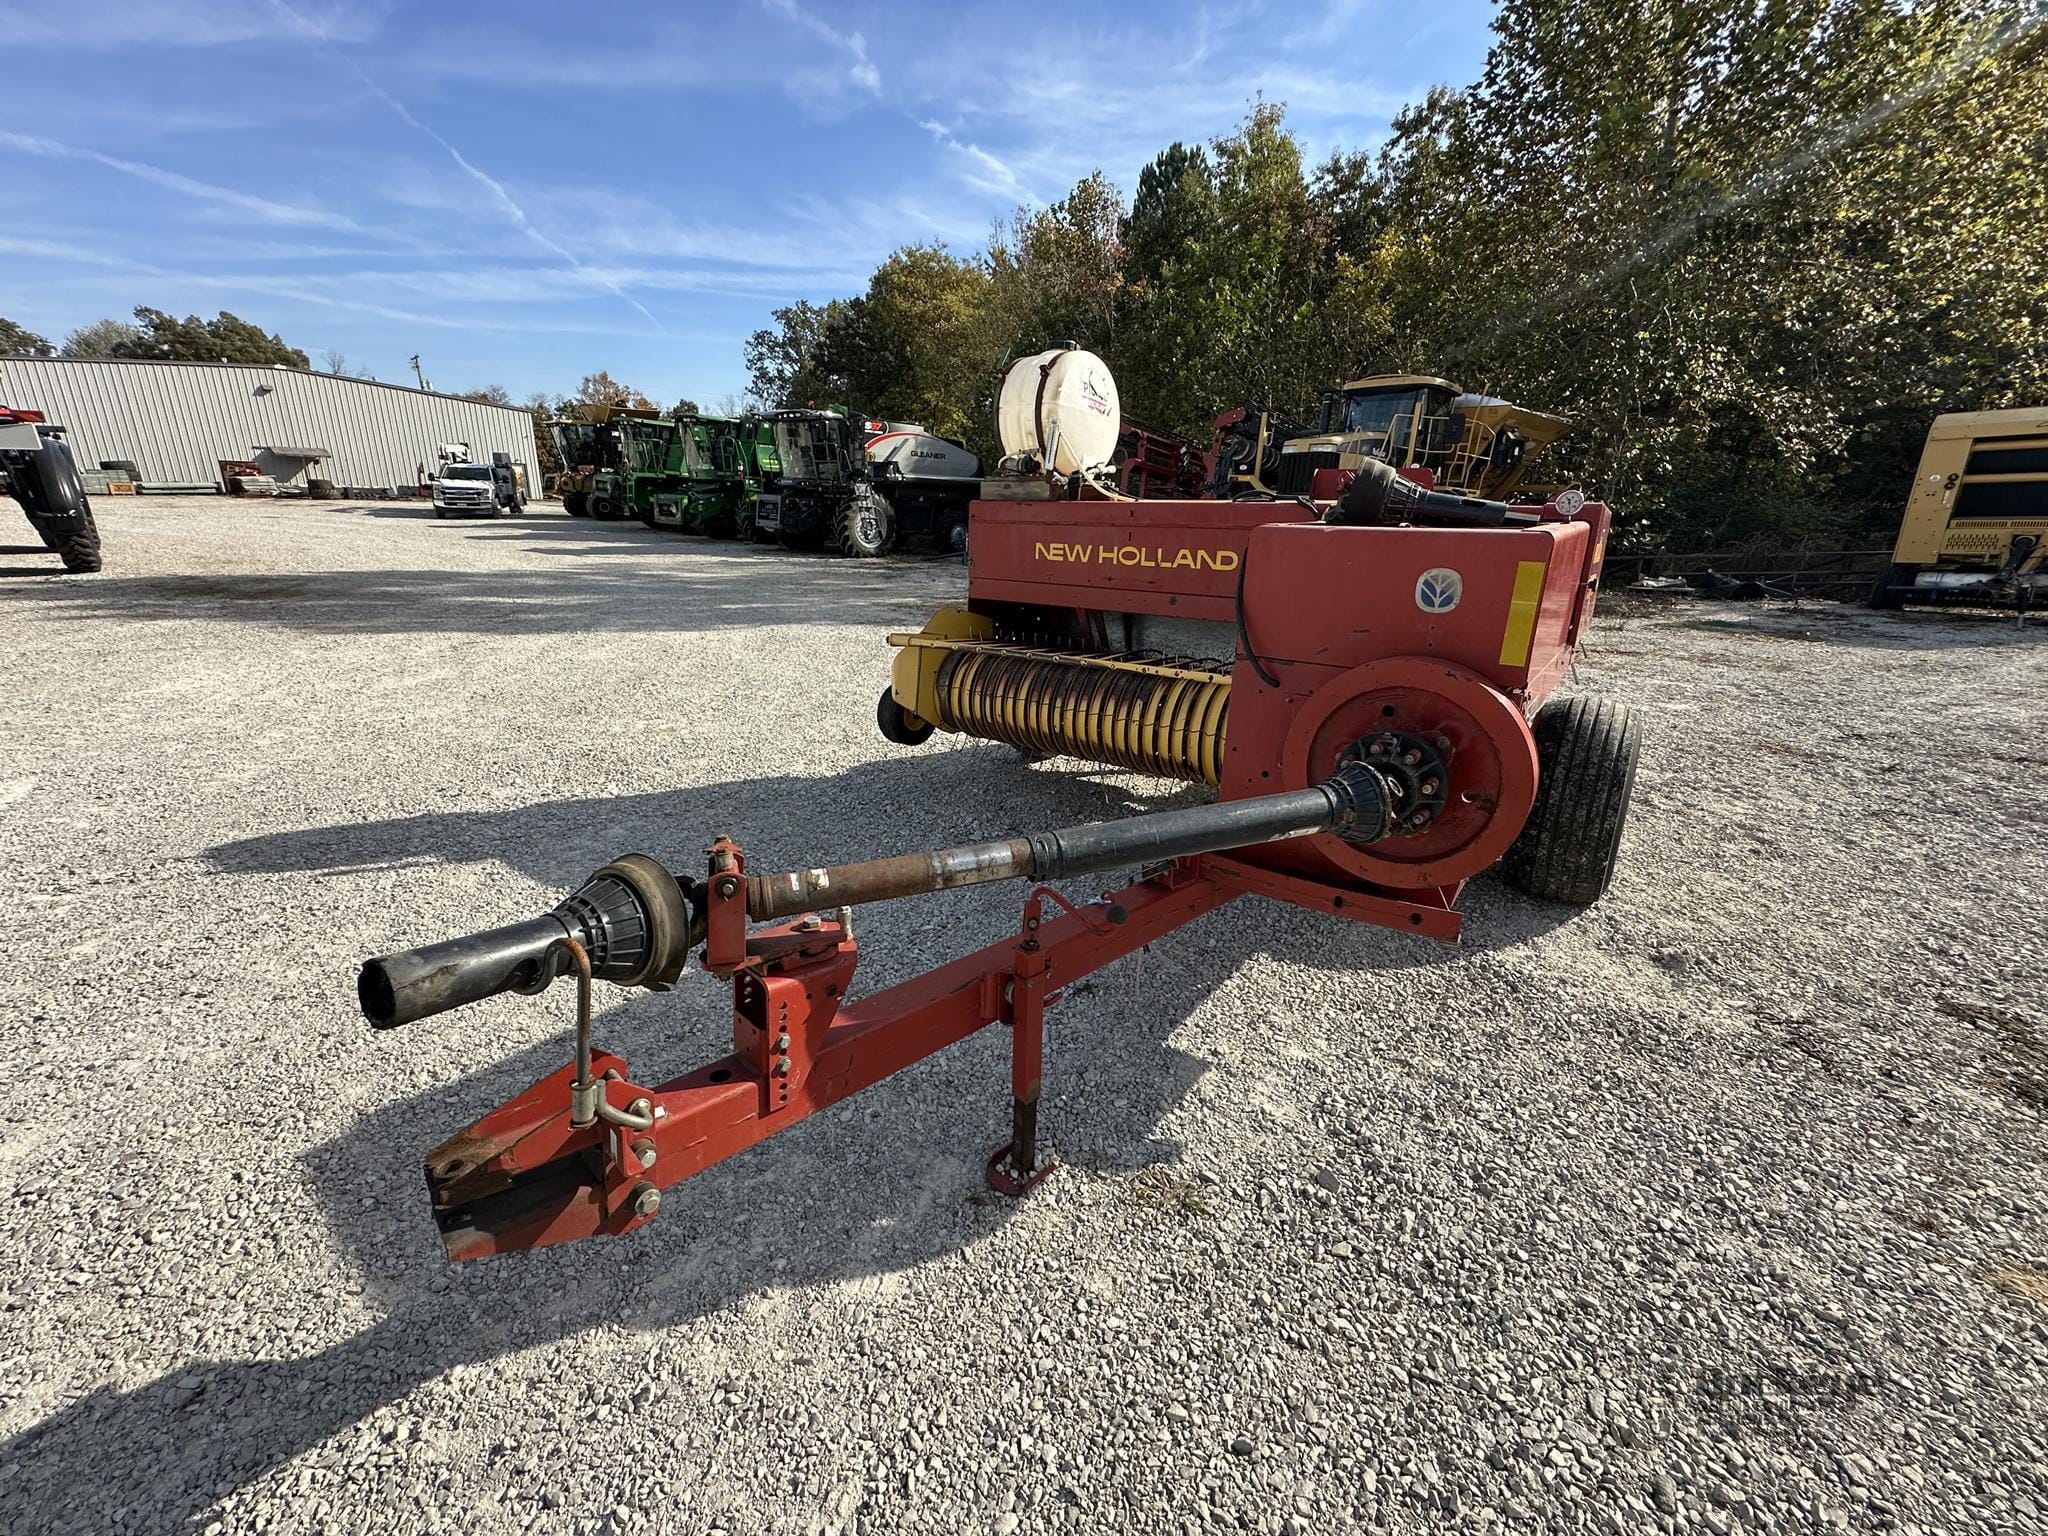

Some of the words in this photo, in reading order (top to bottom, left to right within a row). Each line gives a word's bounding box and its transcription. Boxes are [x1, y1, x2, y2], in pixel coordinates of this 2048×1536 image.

[910, 450, 947, 460] GLEANER
[1035, 542, 1093, 563] NEW
[1098, 545, 1239, 571] HOLLAND
